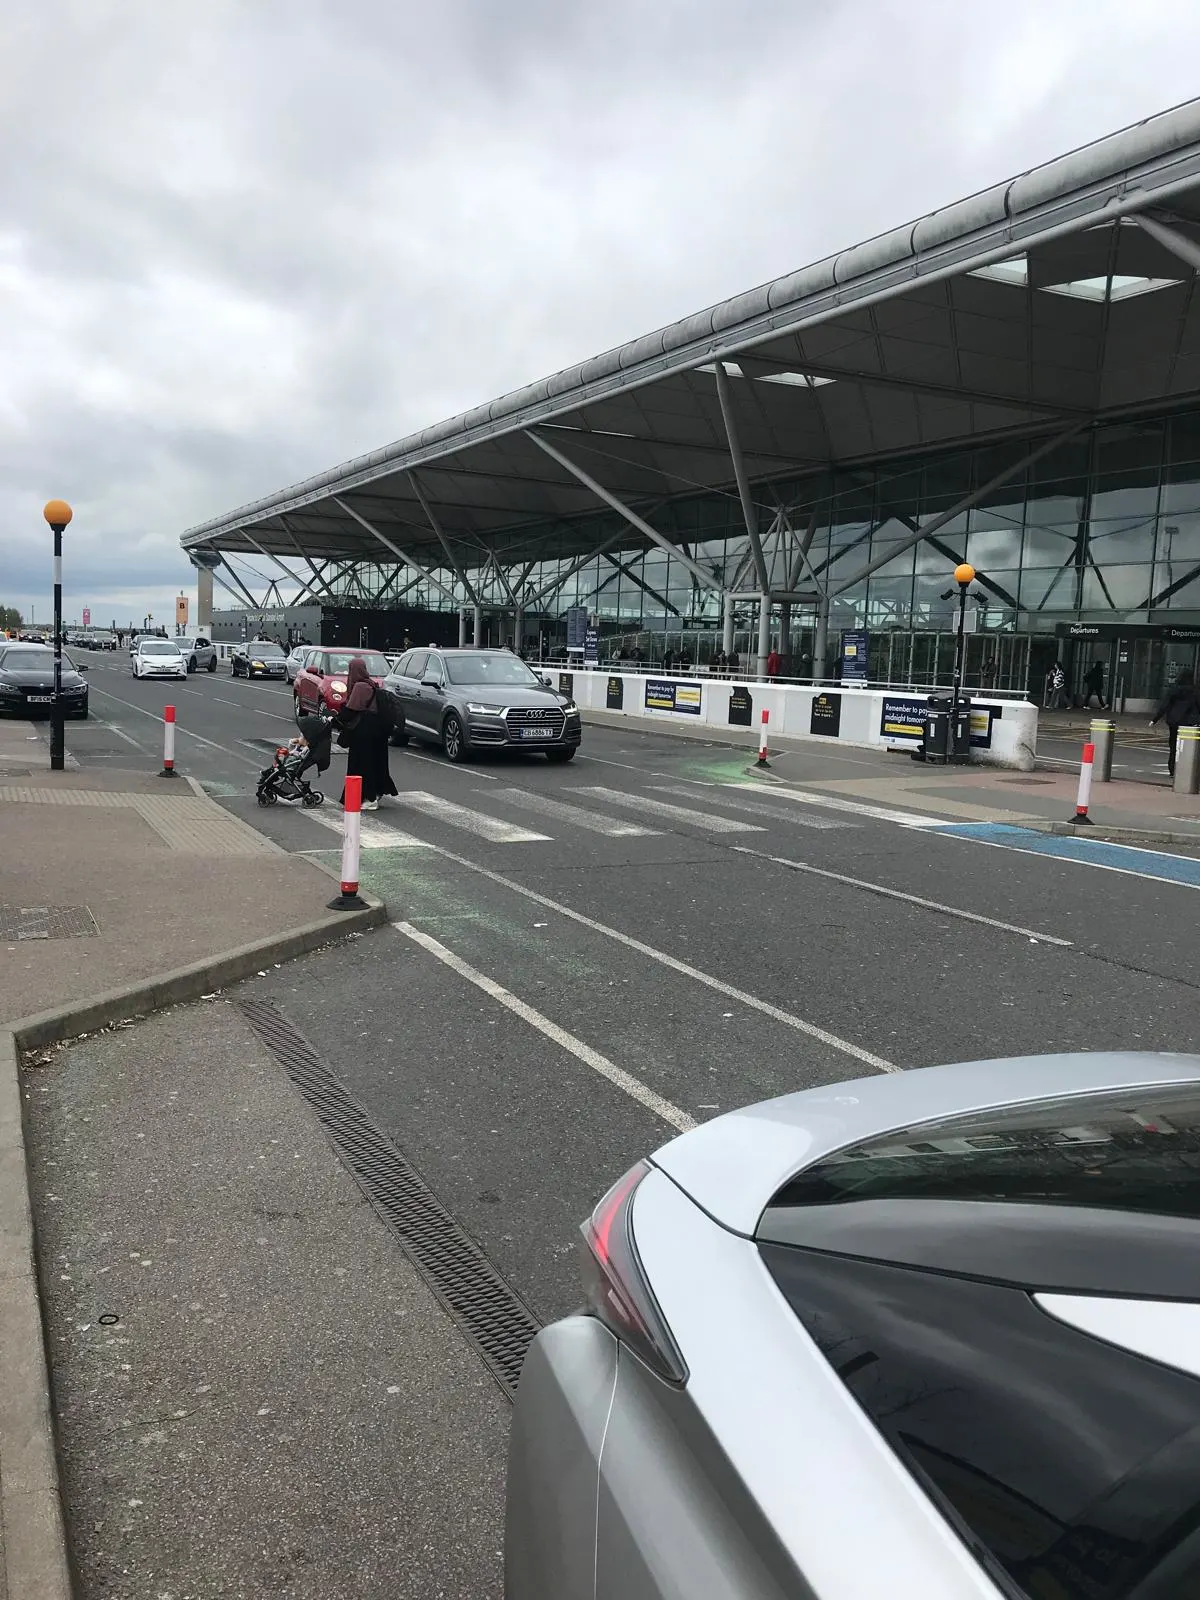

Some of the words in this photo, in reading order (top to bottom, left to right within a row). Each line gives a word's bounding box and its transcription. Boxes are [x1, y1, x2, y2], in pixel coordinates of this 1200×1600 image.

[1171, 629, 1200, 637] Departure
[885, 703, 912, 712] Remember
[918, 708, 927, 716] pay
[884, 712, 906, 723] midnight
[906, 715, 927, 723] tomorr
